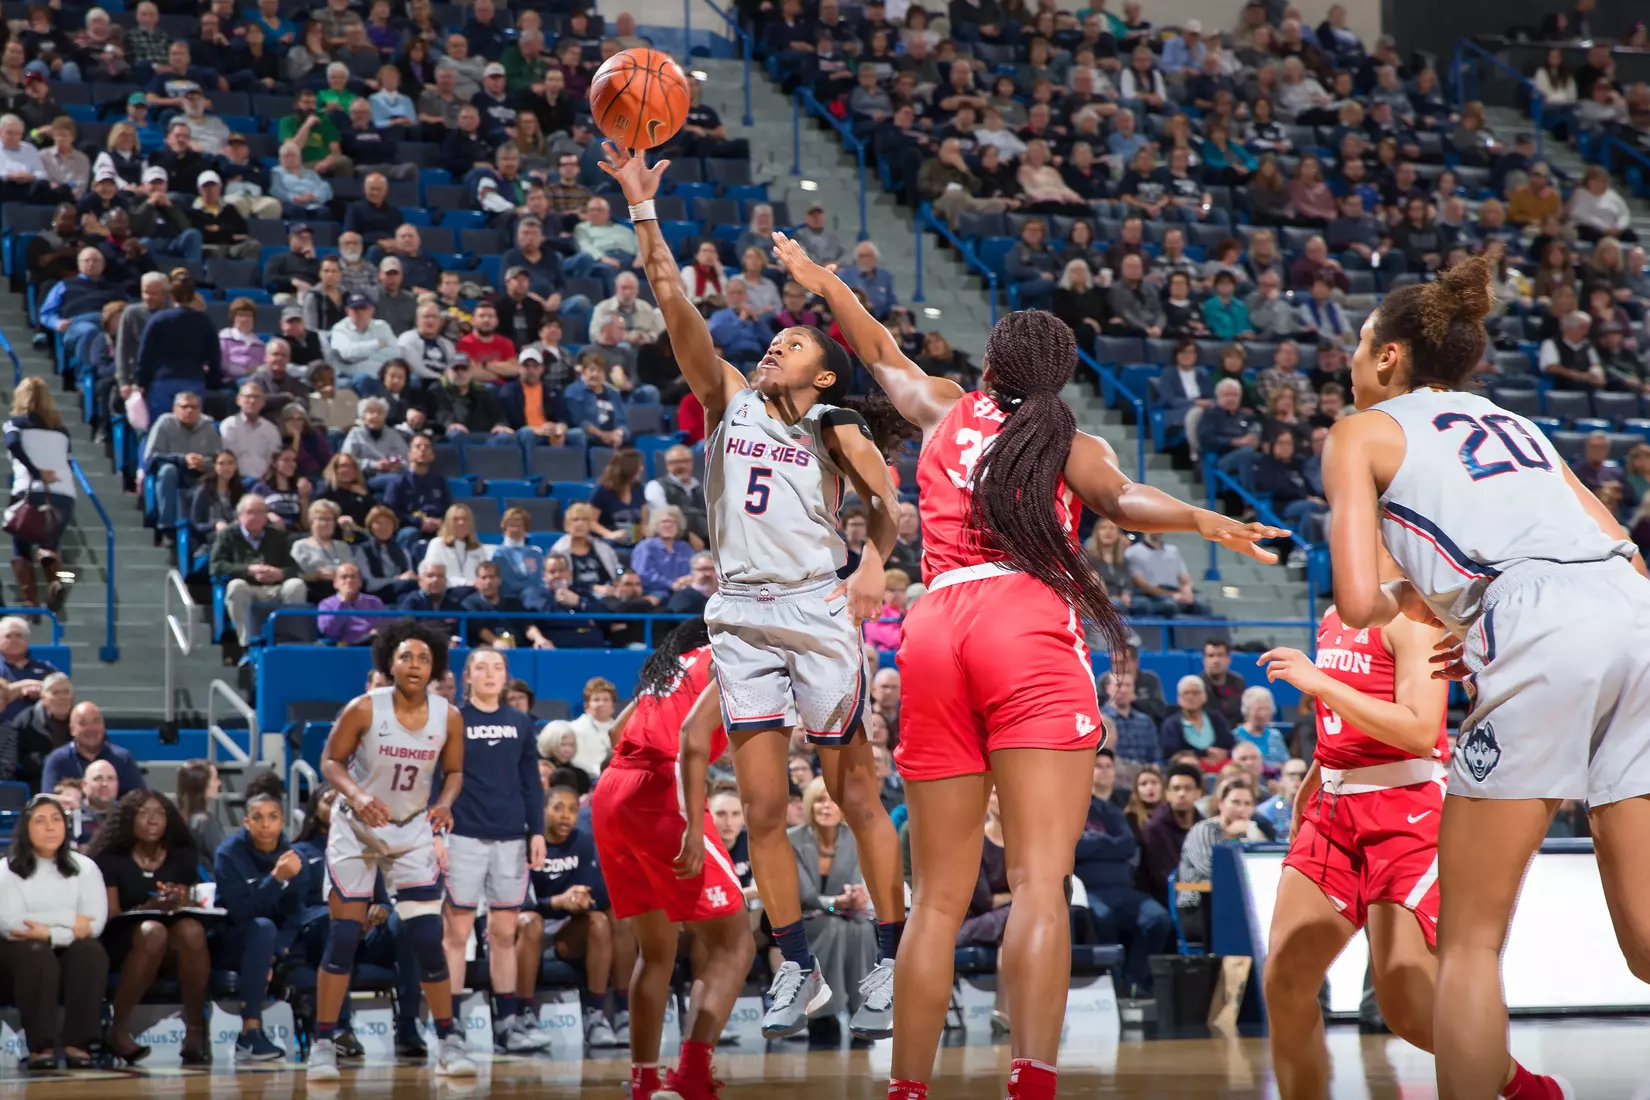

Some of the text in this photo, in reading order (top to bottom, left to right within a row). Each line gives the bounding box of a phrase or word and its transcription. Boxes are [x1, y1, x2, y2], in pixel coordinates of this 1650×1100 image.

[725, 437, 812, 467] HUSKIES
[1432, 412, 1554, 482] 20
[744, 466, 773, 515] 5
[466, 725, 518, 739] UCONN
[378, 744, 436, 761] HUSKIES
[390, 763, 419, 792] 13
